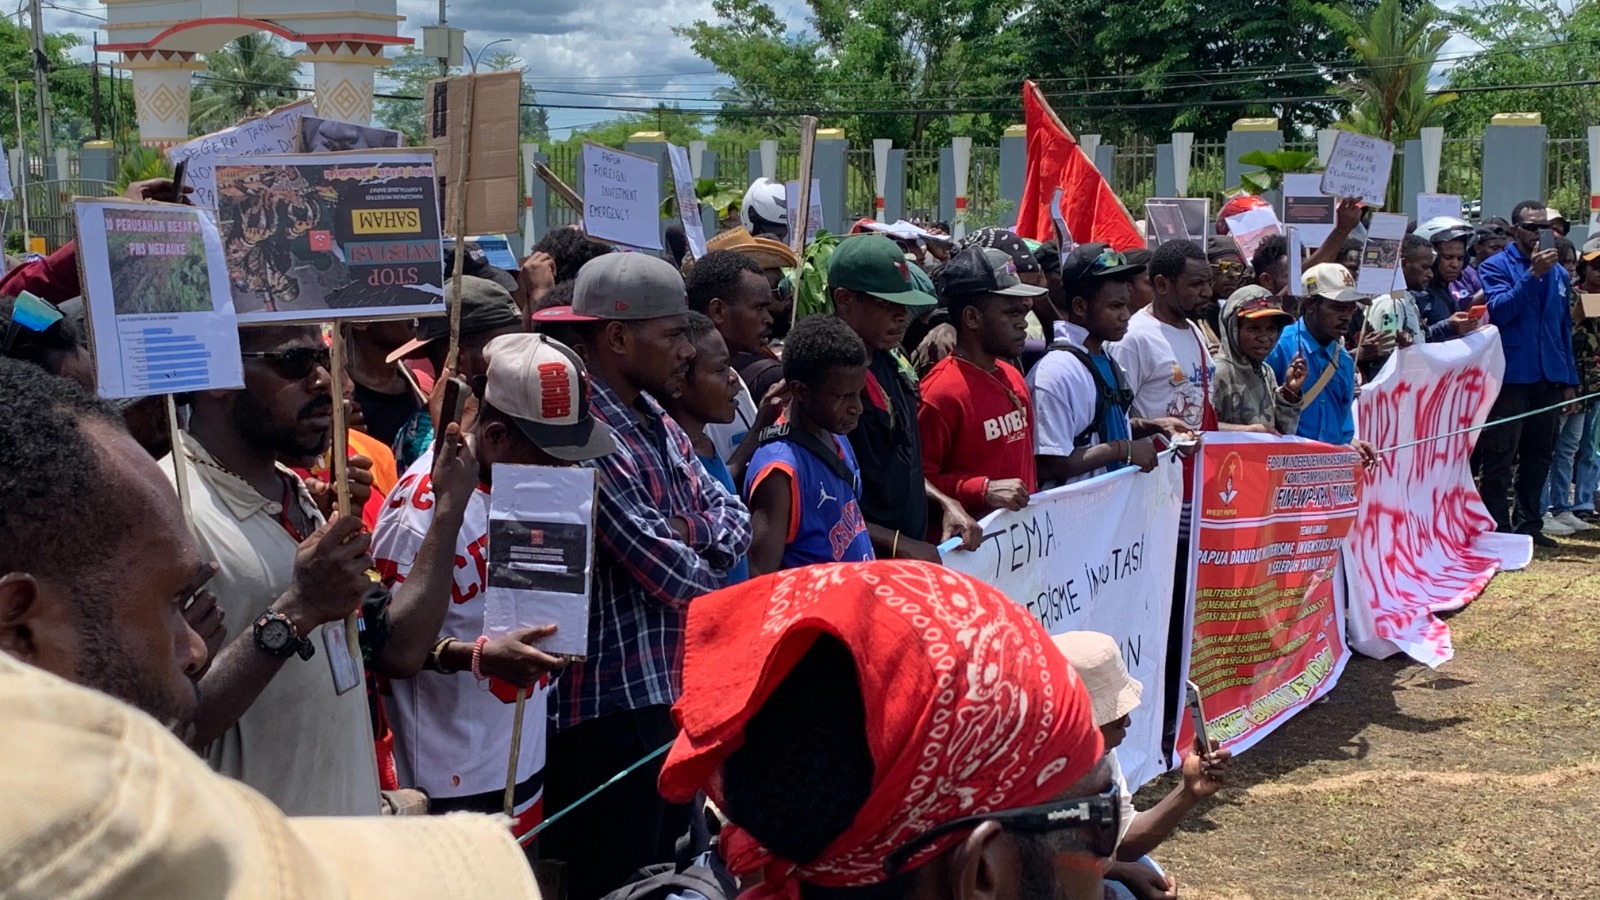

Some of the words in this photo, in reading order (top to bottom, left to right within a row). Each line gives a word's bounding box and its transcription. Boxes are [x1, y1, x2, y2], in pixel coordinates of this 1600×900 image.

[593, 164, 627, 183] FOREIGN
[360, 211, 417, 229] SAHAM
[590, 204, 629, 221] EMERGENCY
[116, 218, 165, 232] PERUSAHAN
[167, 220, 193, 233] BESAR
[148, 242, 186, 256] MERAUKE
[349, 242, 438, 263] INVESTASI
[368, 267, 418, 286] STOP
[980, 510, 1056, 579] TEMA
[1198, 550, 1228, 565] PAPUA
[1229, 548, 1262, 564] DARURAT
